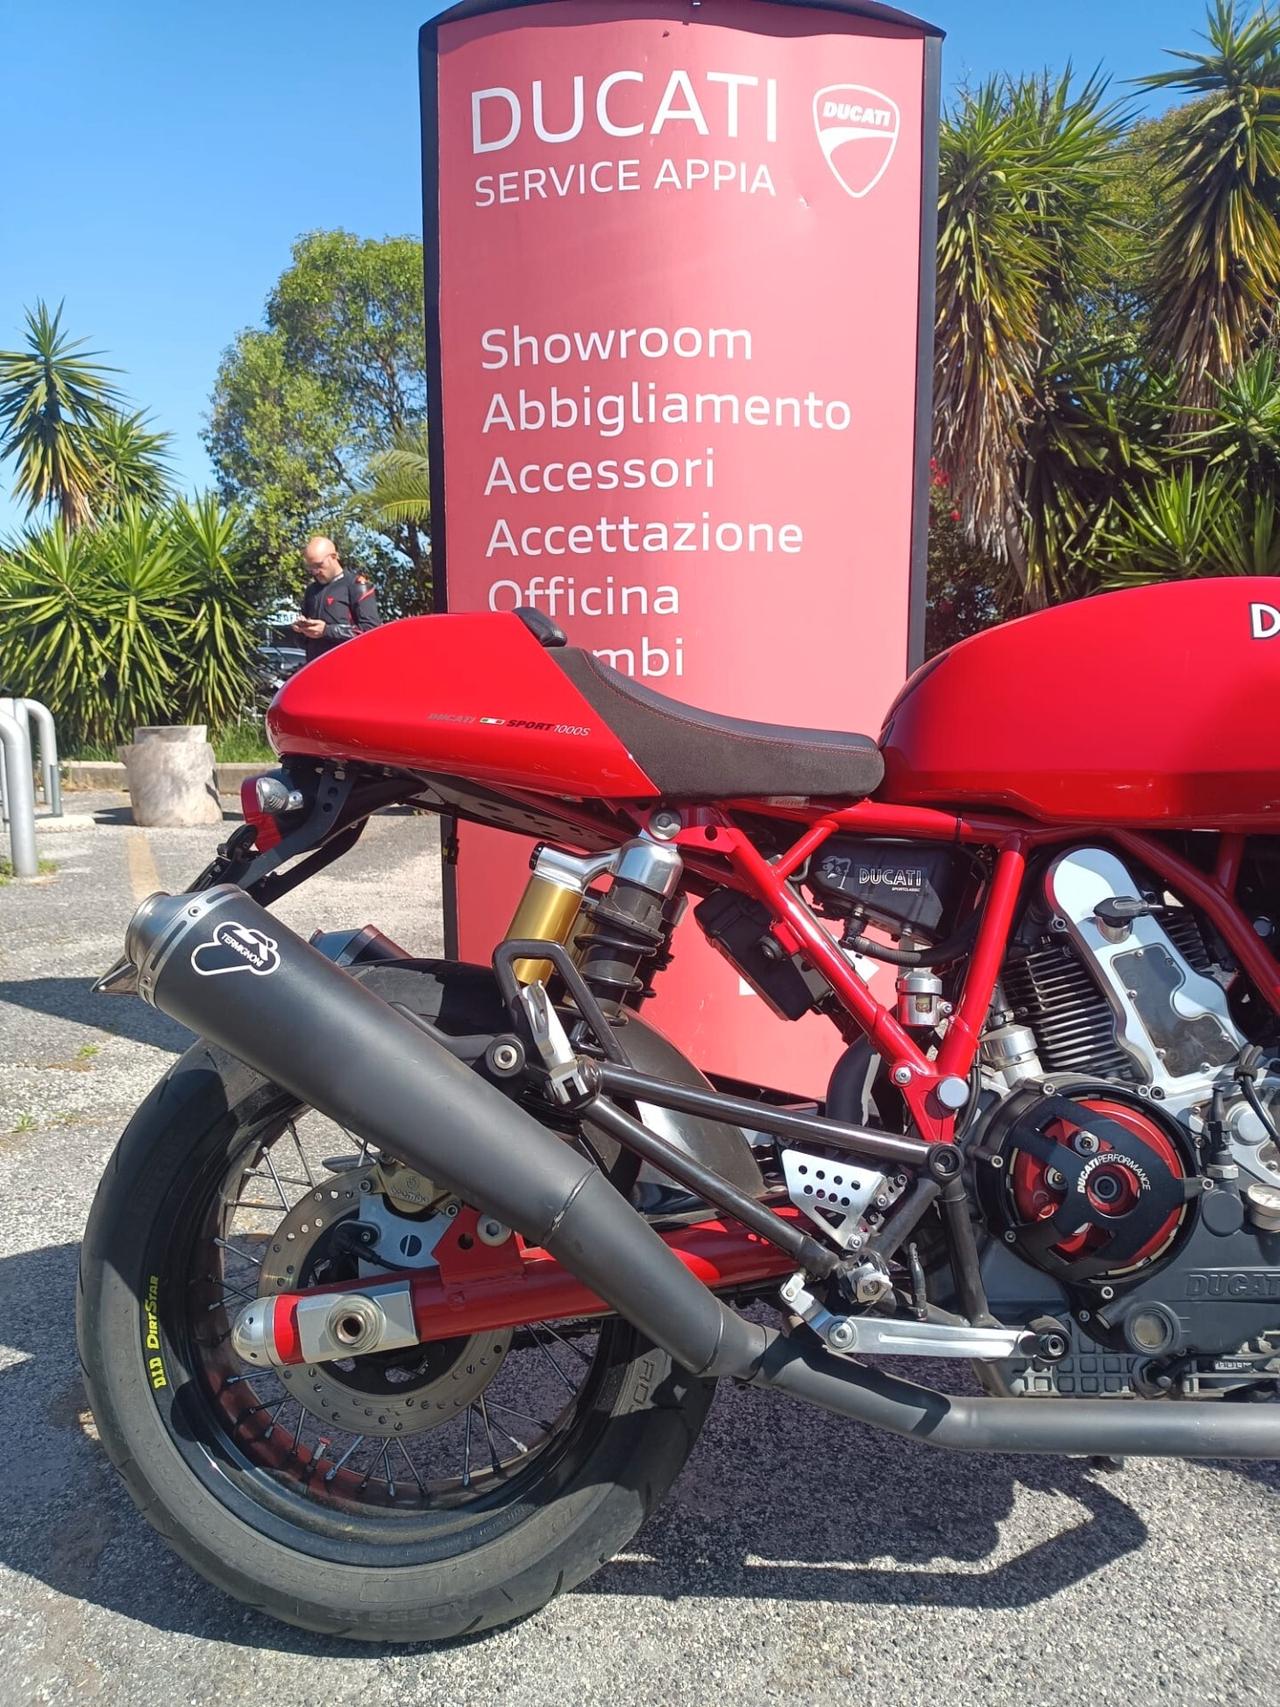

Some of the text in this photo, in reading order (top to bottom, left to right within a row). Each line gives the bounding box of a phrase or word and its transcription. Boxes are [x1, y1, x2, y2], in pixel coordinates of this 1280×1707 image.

[471, 69, 777, 155] DUCATI
[822, 101, 891, 127] DUCATI
[475, 158, 777, 207] SERVICE APPIA
[481, 324, 753, 370] Showroom
[482, 381, 852, 438] Abbigliamento
[483, 447, 715, 496] Accessori
[485, 511, 804, 558] Accettazione
[488, 575, 680, 617] Officina
[428, 713, 475, 724] DUCATI
[858, 867, 922, 886] DUCATI
[221, 932, 264, 967] TERMIGNONI
